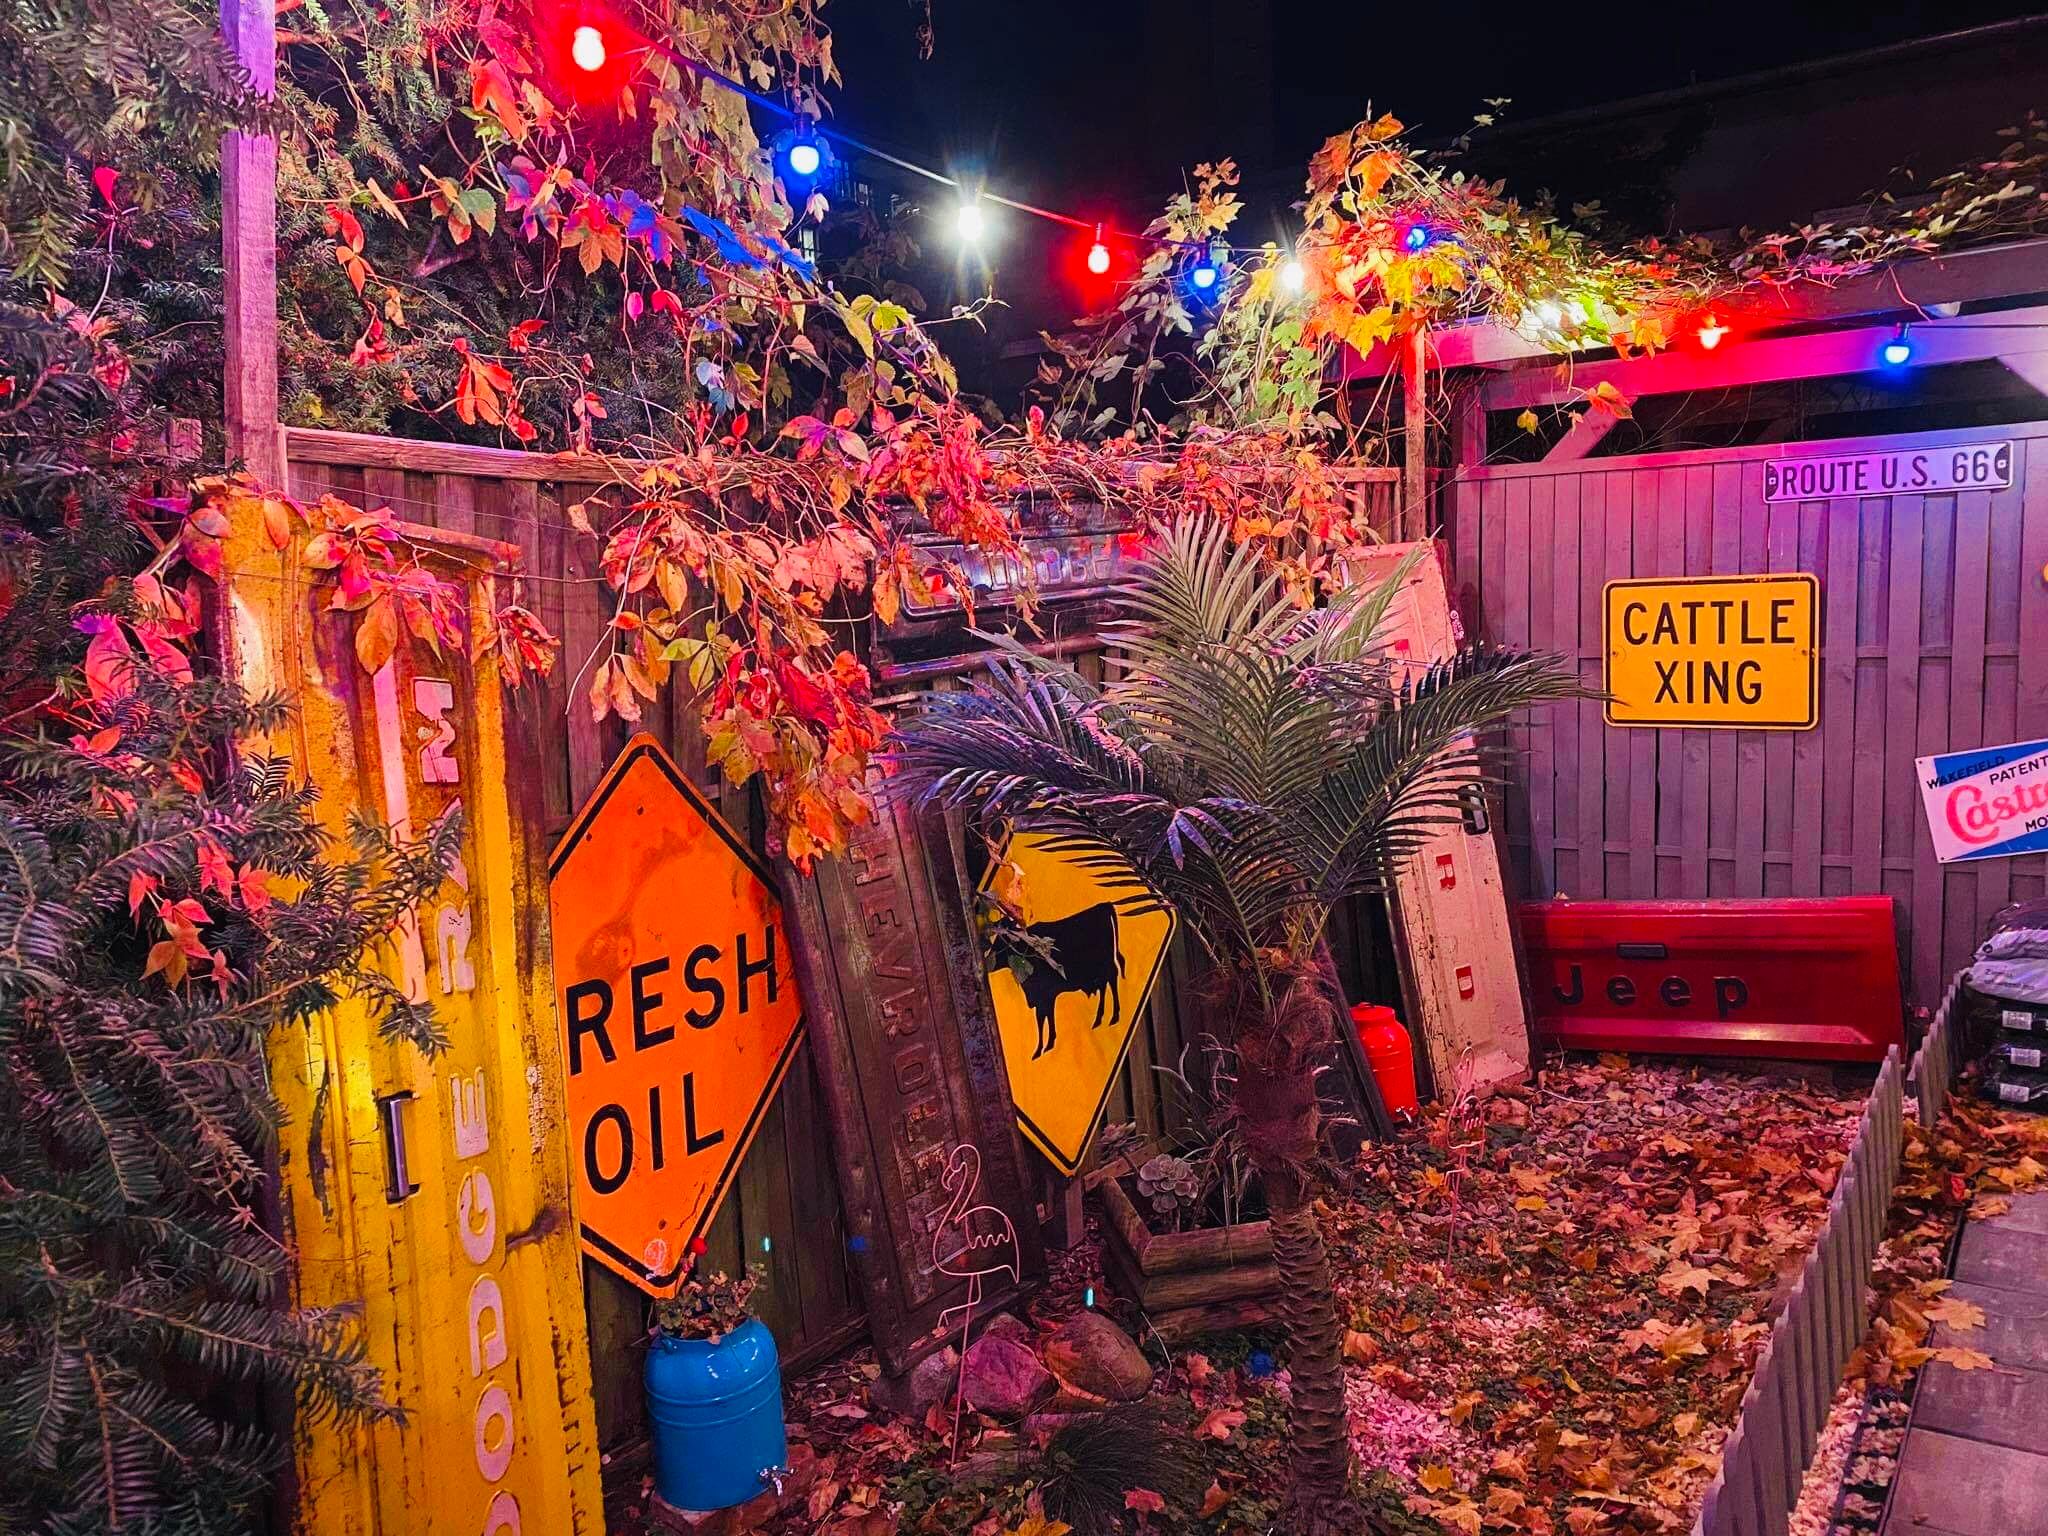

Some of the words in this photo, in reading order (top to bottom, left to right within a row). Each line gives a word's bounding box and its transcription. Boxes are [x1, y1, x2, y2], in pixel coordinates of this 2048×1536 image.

[1781, 459, 1869, 496] ROUTE
[1880, 455, 1938, 489] U.S.
[1951, 450, 1990, 484] 66
[1623, 599, 1796, 645] CATTLE
[1653, 659, 1763, 705] XING
[1926, 755, 2005, 790] WAKEFIELD
[1945, 783, 2048, 845] Castr
[2025, 814, 2048, 833] MO
[1552, 963, 1750, 1020] Jeep
[582, 1072, 725, 1196] OIL
